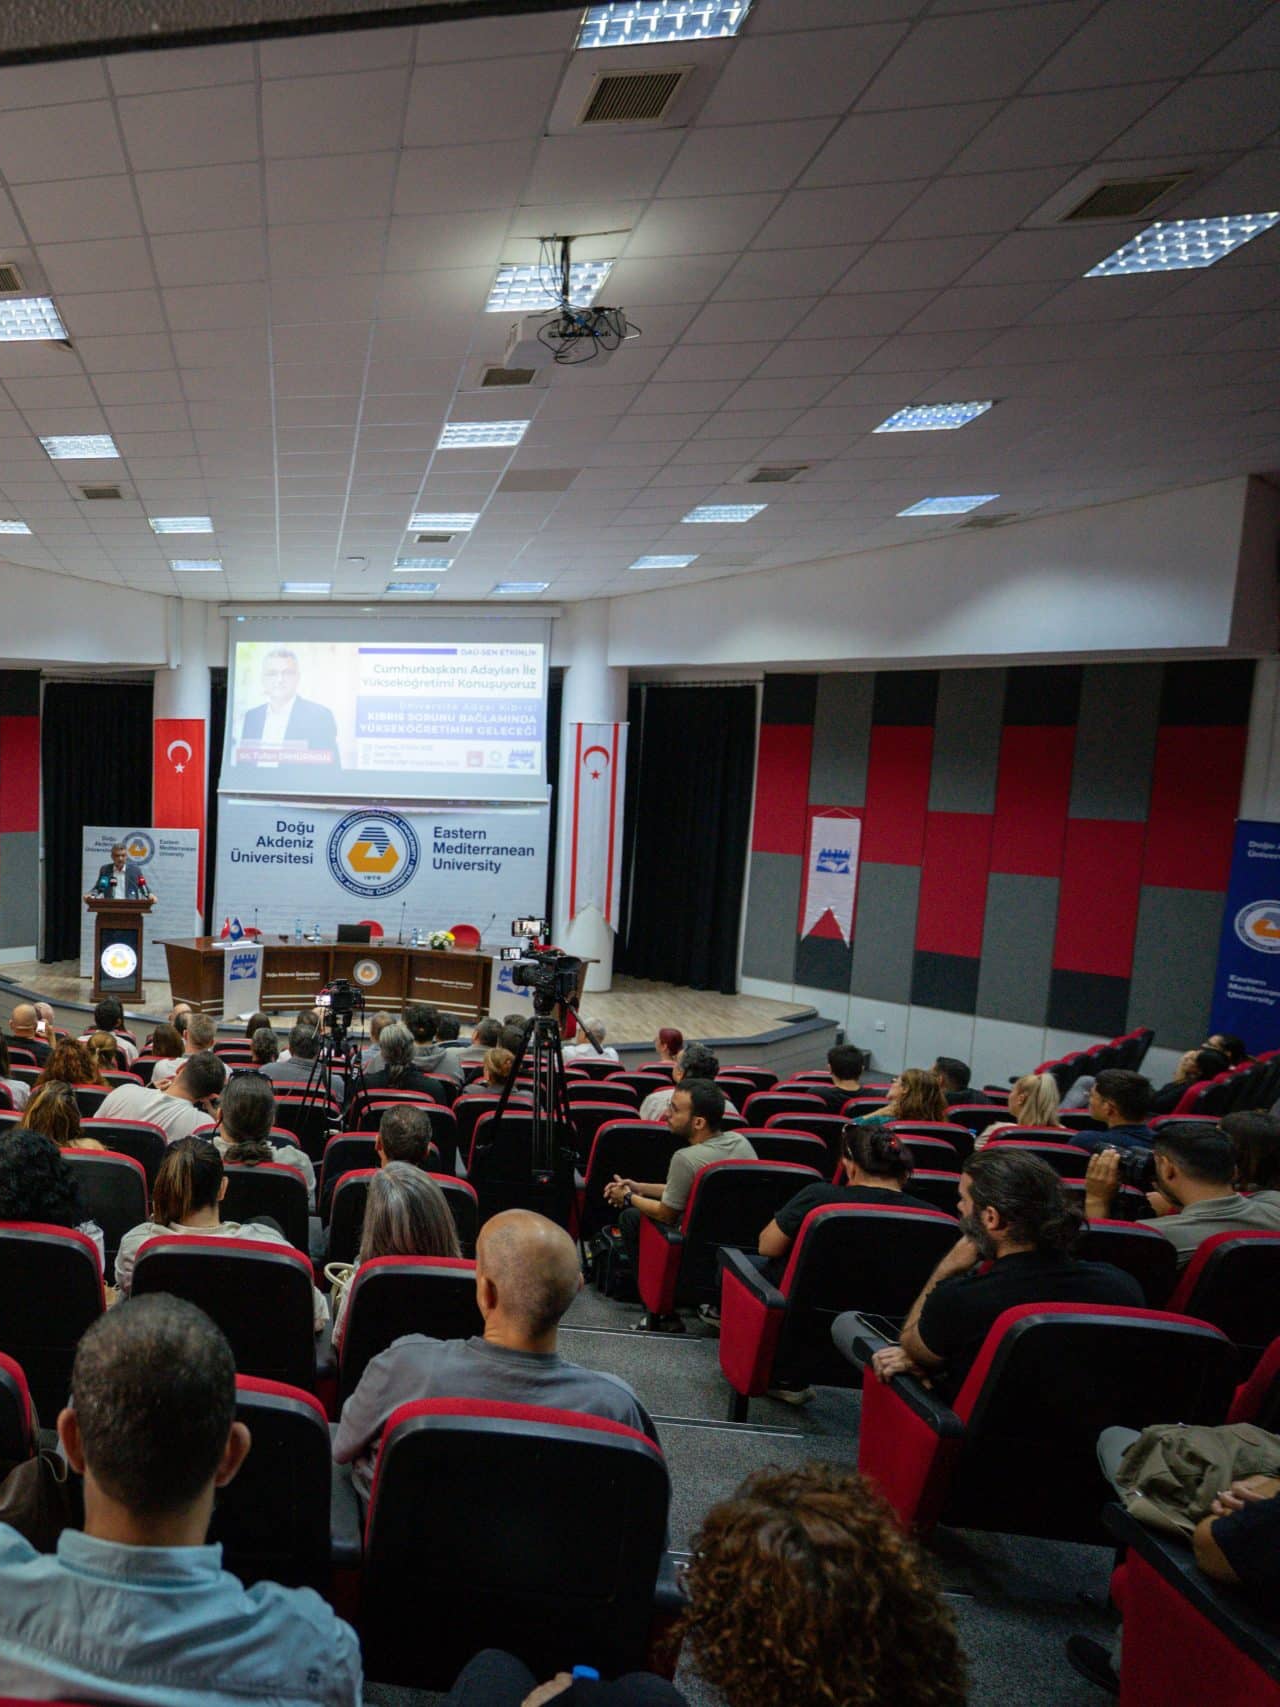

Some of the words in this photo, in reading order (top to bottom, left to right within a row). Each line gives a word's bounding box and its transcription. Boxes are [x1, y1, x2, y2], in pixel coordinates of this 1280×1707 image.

[373, 664, 467, 675] Cumhurbaşkanı
[458, 679, 536, 692] Konuşuyoruz
[367, 711, 404, 721] KIBRIS
[407, 711, 455, 722] SORUNU
[459, 711, 537, 724] BAĞLAMINDA
[359, 722, 473, 734] YÜKSEKÖĞRETİMİN
[477, 724, 537, 736] GELECEĞİ
[276, 820, 315, 836] Doğu
[433, 827, 487, 840] Eastern
[256, 836, 314, 849] Akdeniz
[433, 841, 535, 857] Mediterranean
[231, 850, 314, 865] Üniversitesi
[432, 857, 502, 873] University
[1227, 991, 1277, 1006] University
